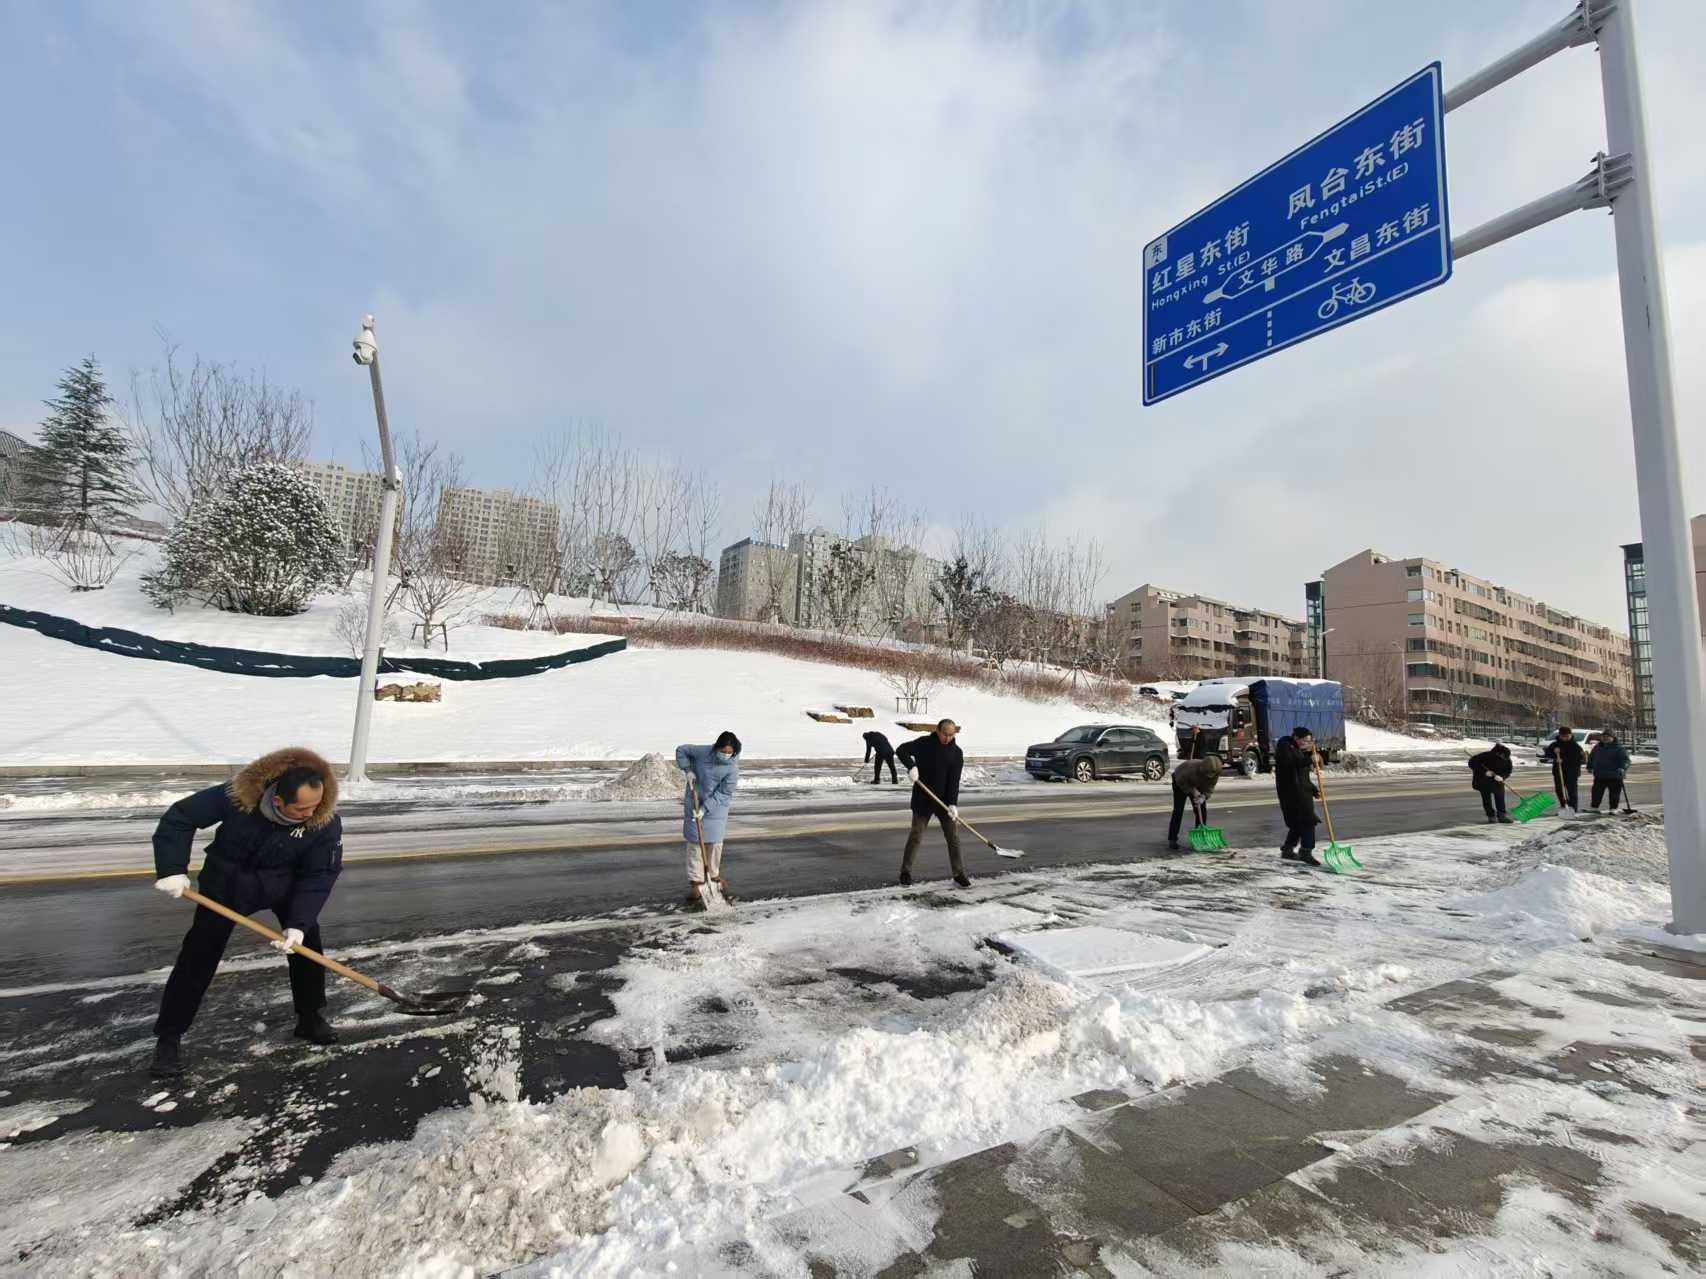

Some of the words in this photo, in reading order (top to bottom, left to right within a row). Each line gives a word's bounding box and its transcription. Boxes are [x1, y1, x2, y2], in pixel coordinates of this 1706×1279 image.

[1287, 117, 1425, 220] 凤台东街
[1152, 221, 1250, 295] 红星东街
[1238, 243, 1304, 290] 文华路
[1323, 203, 1431, 272] 文昌东街
[1151, 275, 1208, 311] Hongxing
[1217, 251, 1250, 275] St.(E)
[1152, 308, 1222, 355] 新市东街
